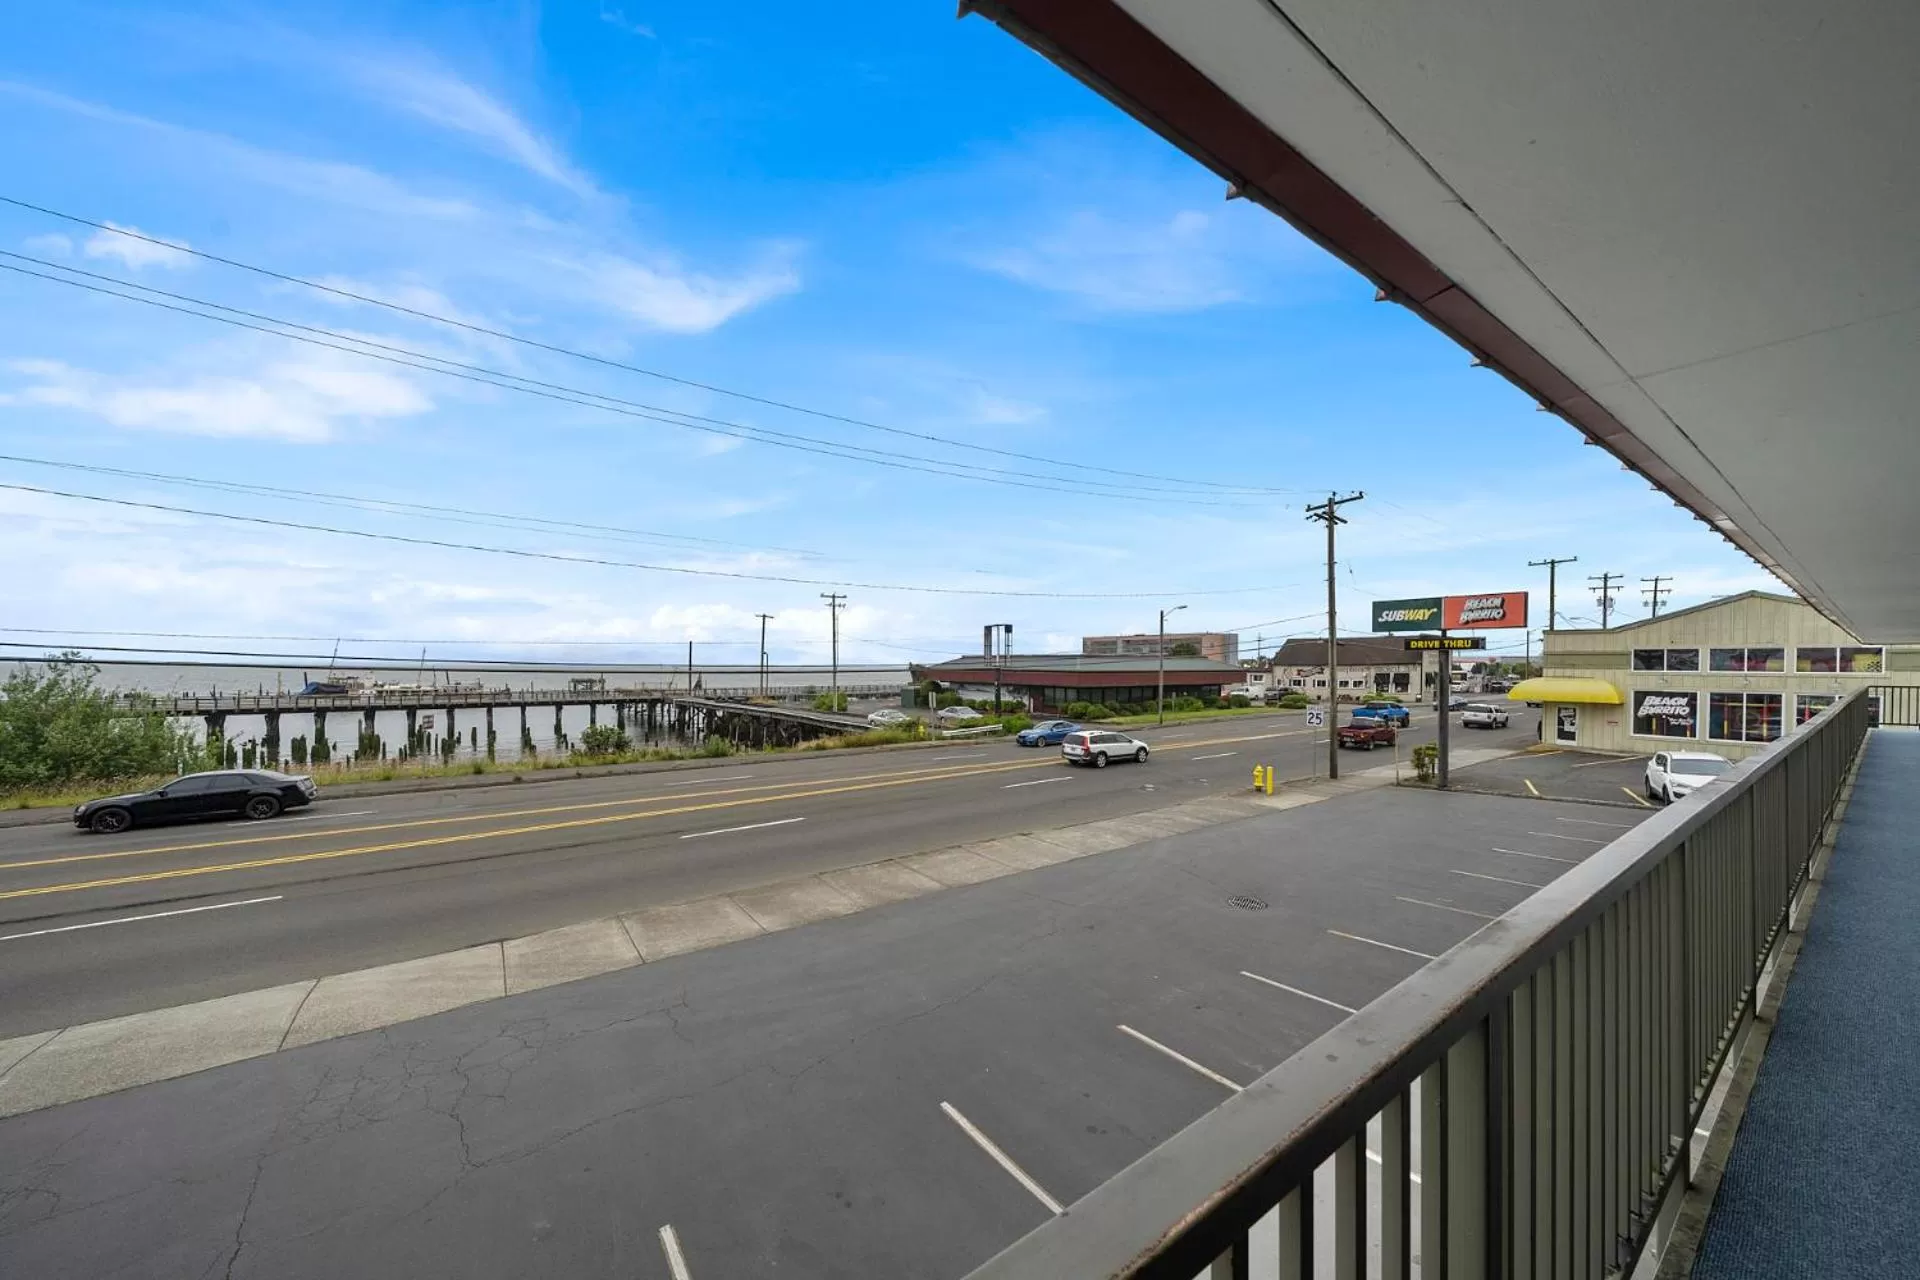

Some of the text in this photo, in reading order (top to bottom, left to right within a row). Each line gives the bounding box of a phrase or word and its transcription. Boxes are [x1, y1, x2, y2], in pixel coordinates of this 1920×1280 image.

[1378, 608, 1434, 622] SUBWAY
[1410, 639, 1472, 649] DRIVE THRU
[1643, 695, 1689, 706] BEACH
[1638, 705, 1690, 716] BURRITO
[1308, 712, 1322, 725] 25
